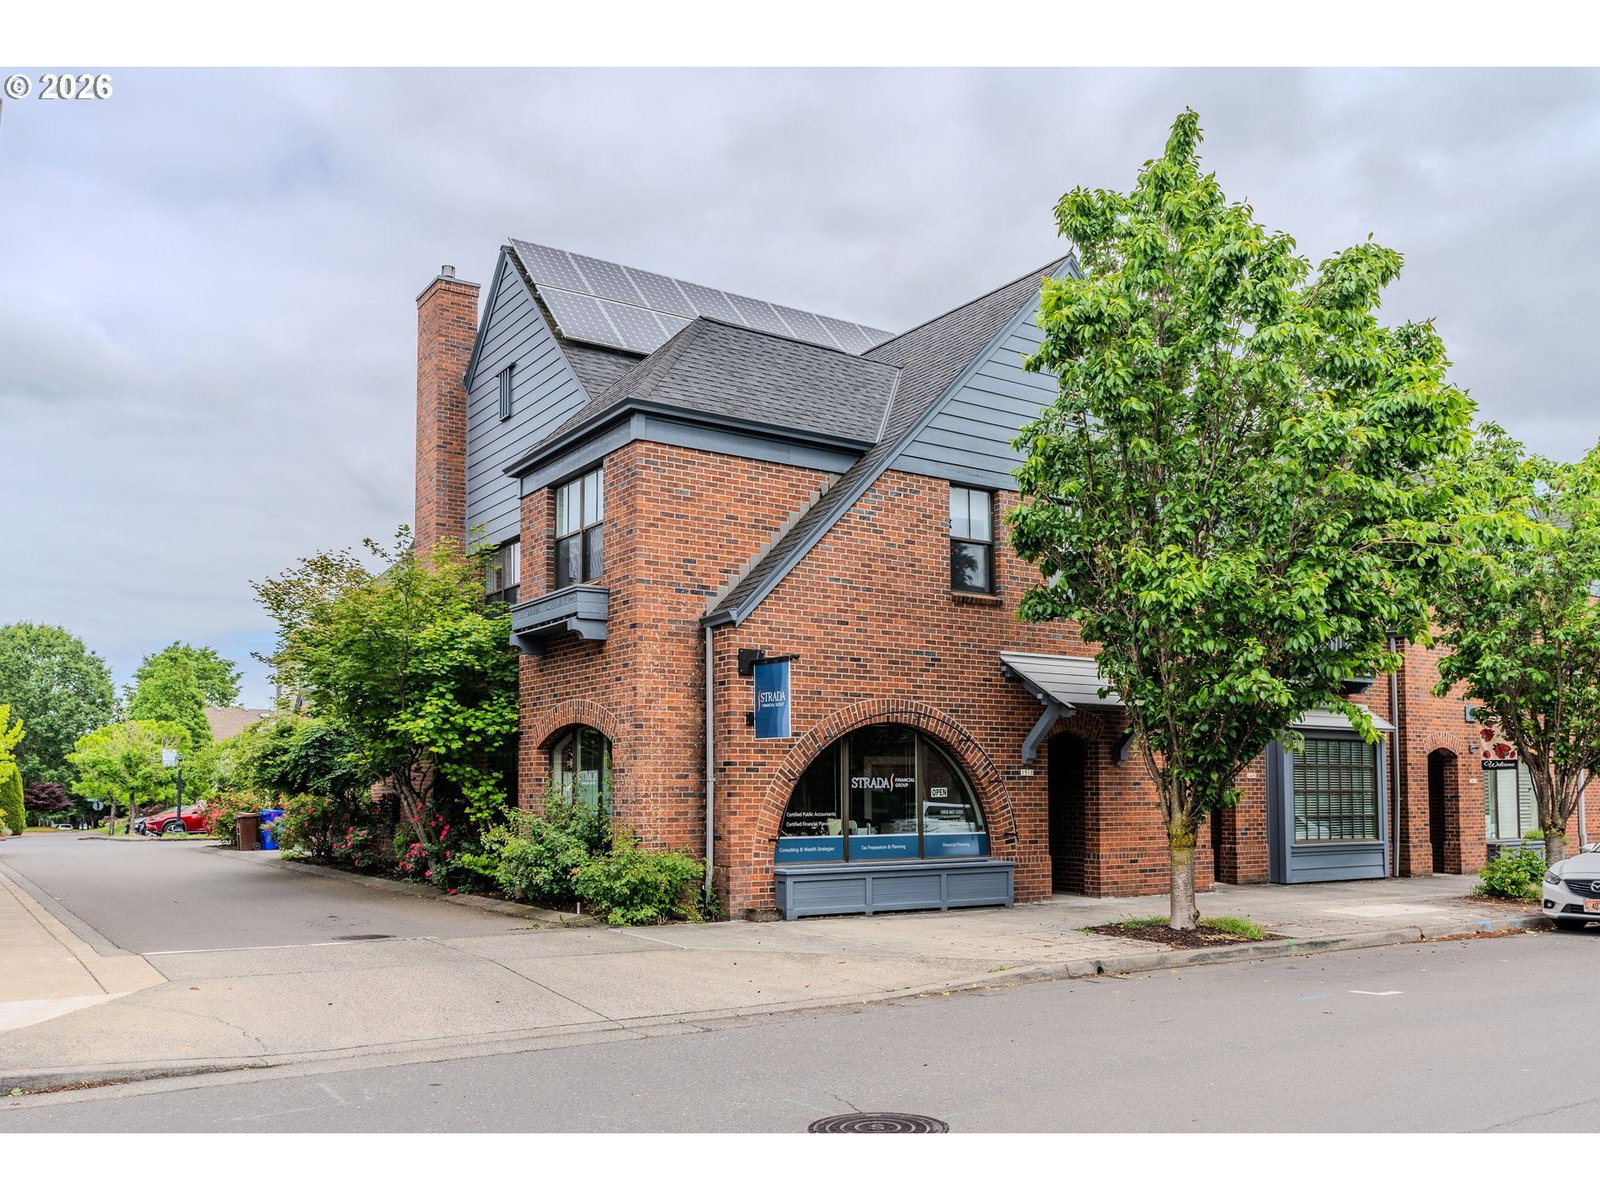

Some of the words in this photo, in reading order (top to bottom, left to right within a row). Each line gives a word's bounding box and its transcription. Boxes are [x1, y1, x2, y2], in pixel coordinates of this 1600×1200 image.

[760, 691, 786, 702] STRADA
[851, 777, 890, 788] STRADA
[932, 788, 946, 796] OPEN
